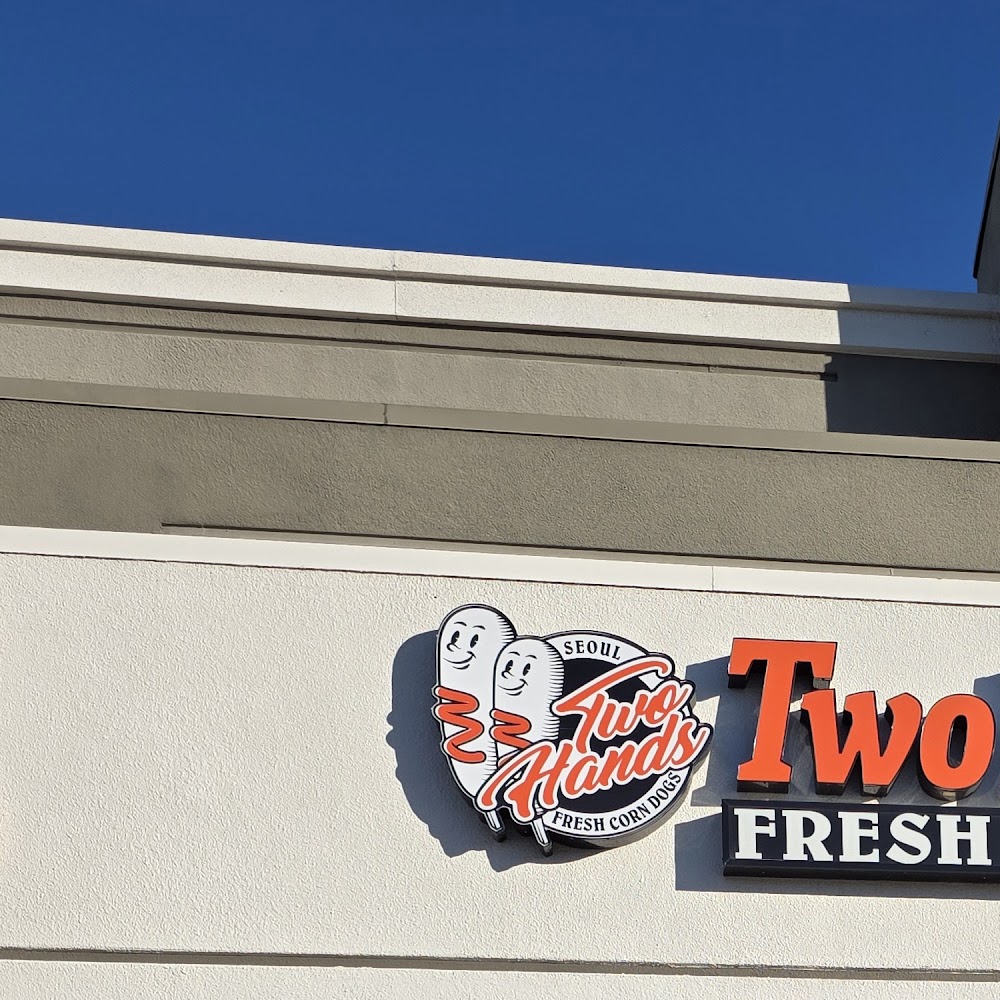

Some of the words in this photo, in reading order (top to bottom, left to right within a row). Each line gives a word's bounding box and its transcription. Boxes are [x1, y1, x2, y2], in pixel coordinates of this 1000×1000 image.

[564, 640, 622, 661] SEOUL
[555, 660, 689, 754] Two
[728, 638, 997, 793] Two
[478, 713, 708, 818] Hands
[552, 811, 606, 832] FRESH
[609, 806, 651, 831] CORN
[648, 772, 682, 810] DOGS
[732, 807, 991, 867] FRESH
